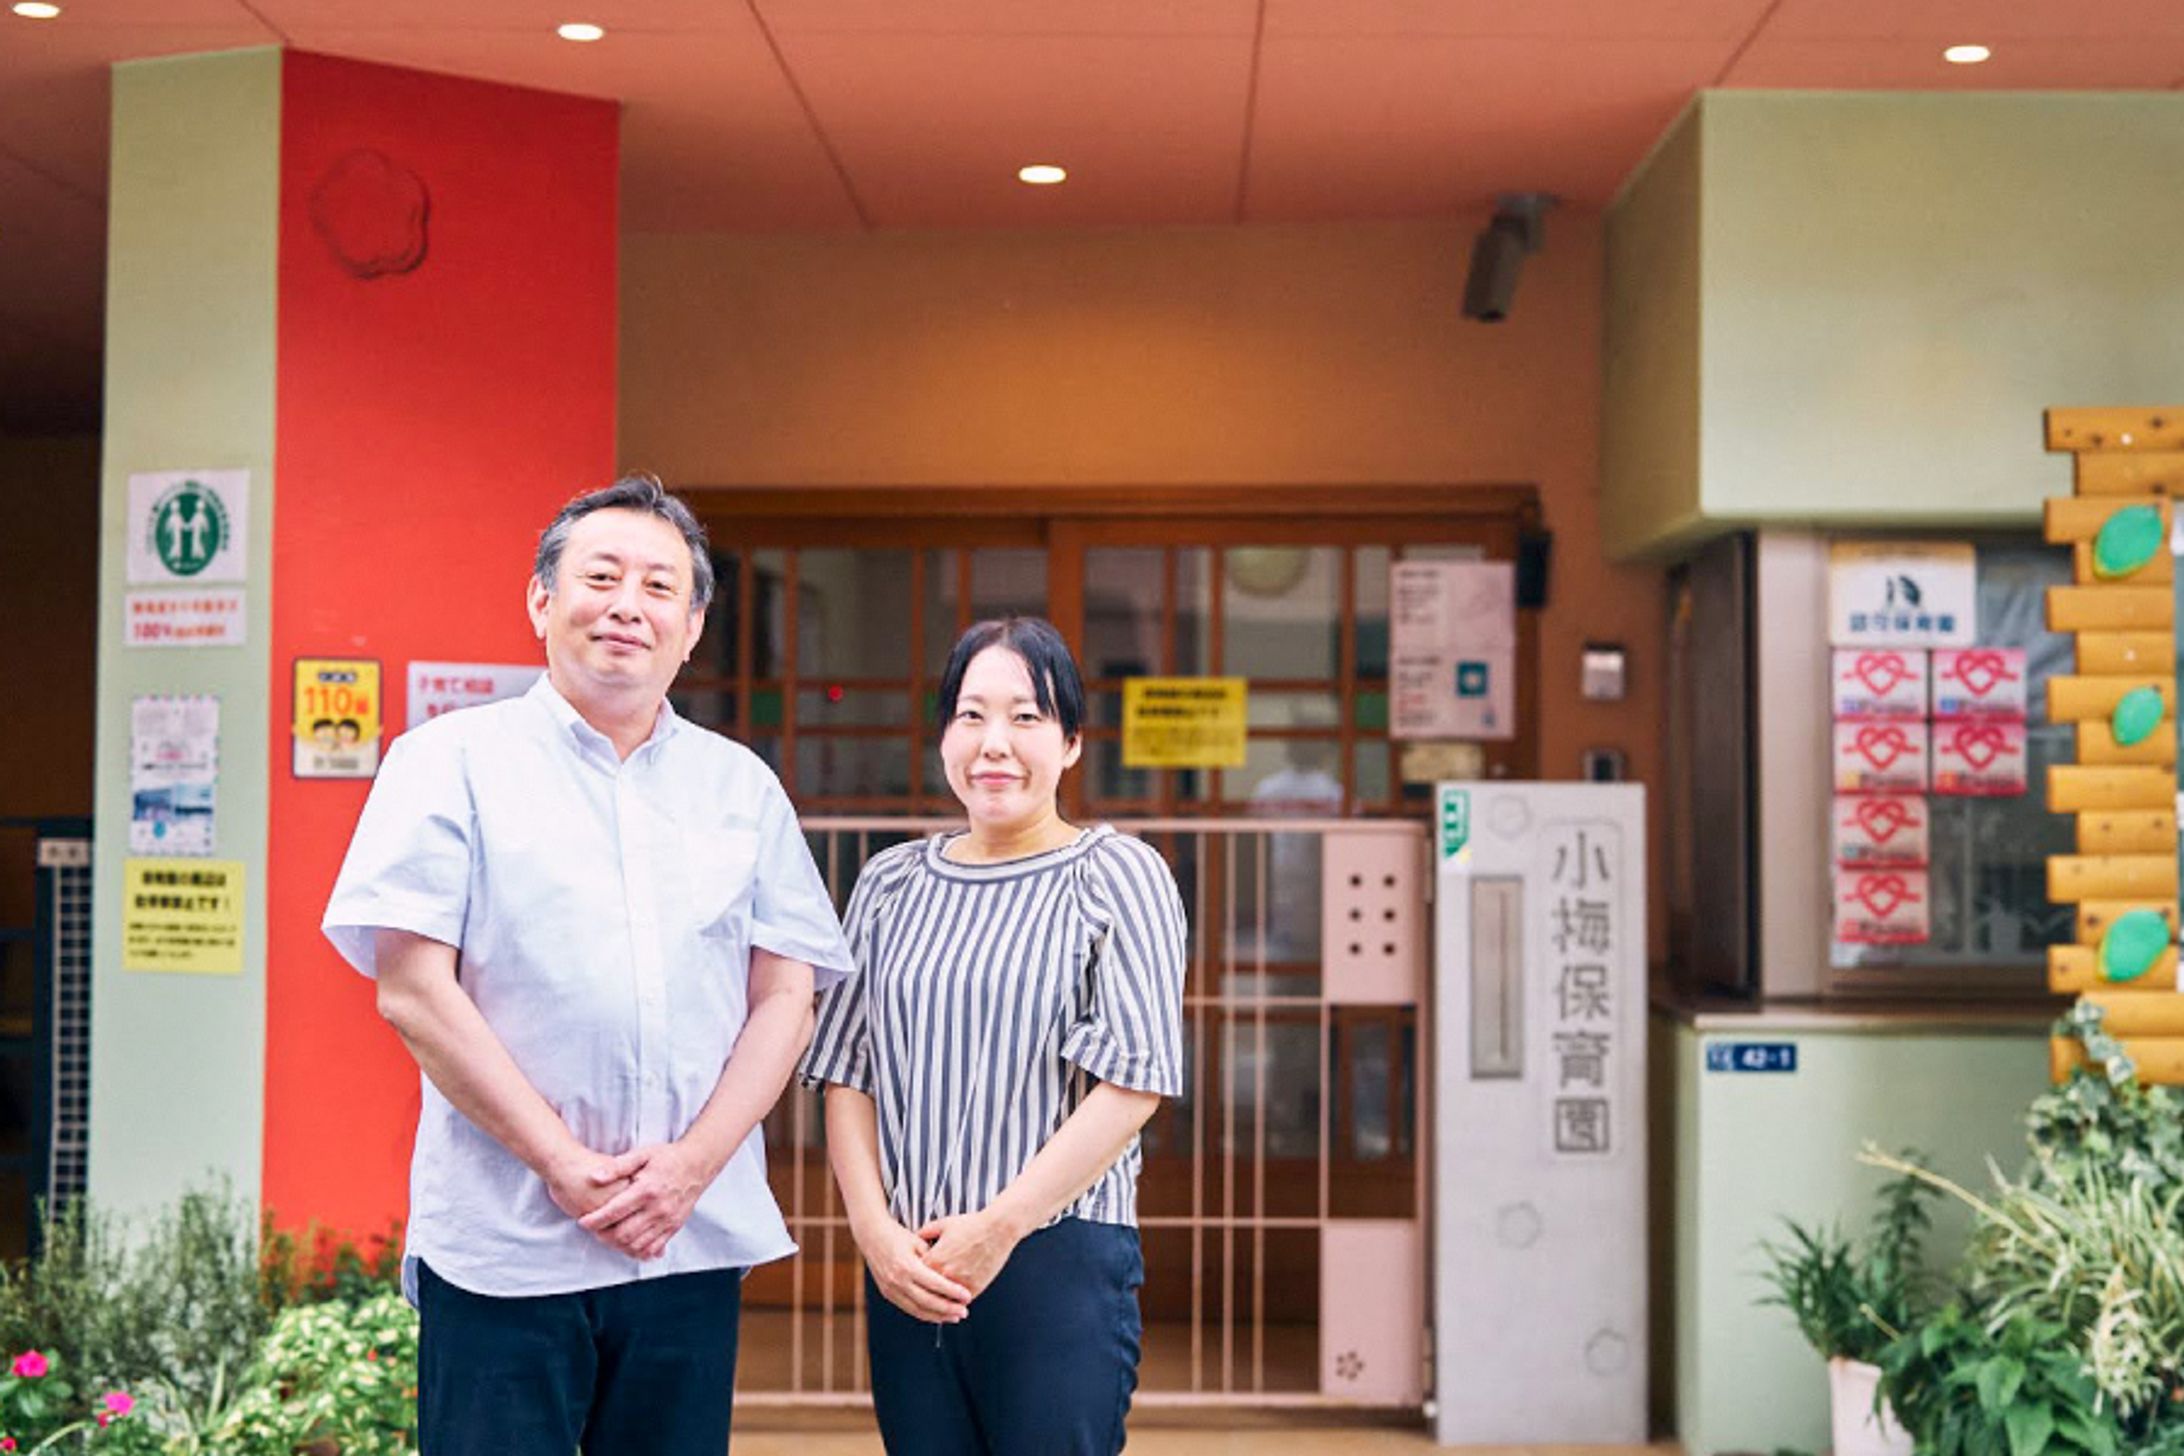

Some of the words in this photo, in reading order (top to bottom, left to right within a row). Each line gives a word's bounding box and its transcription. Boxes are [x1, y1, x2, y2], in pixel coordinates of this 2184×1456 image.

[1551, 829, 1611, 1153] 小梅保育園
